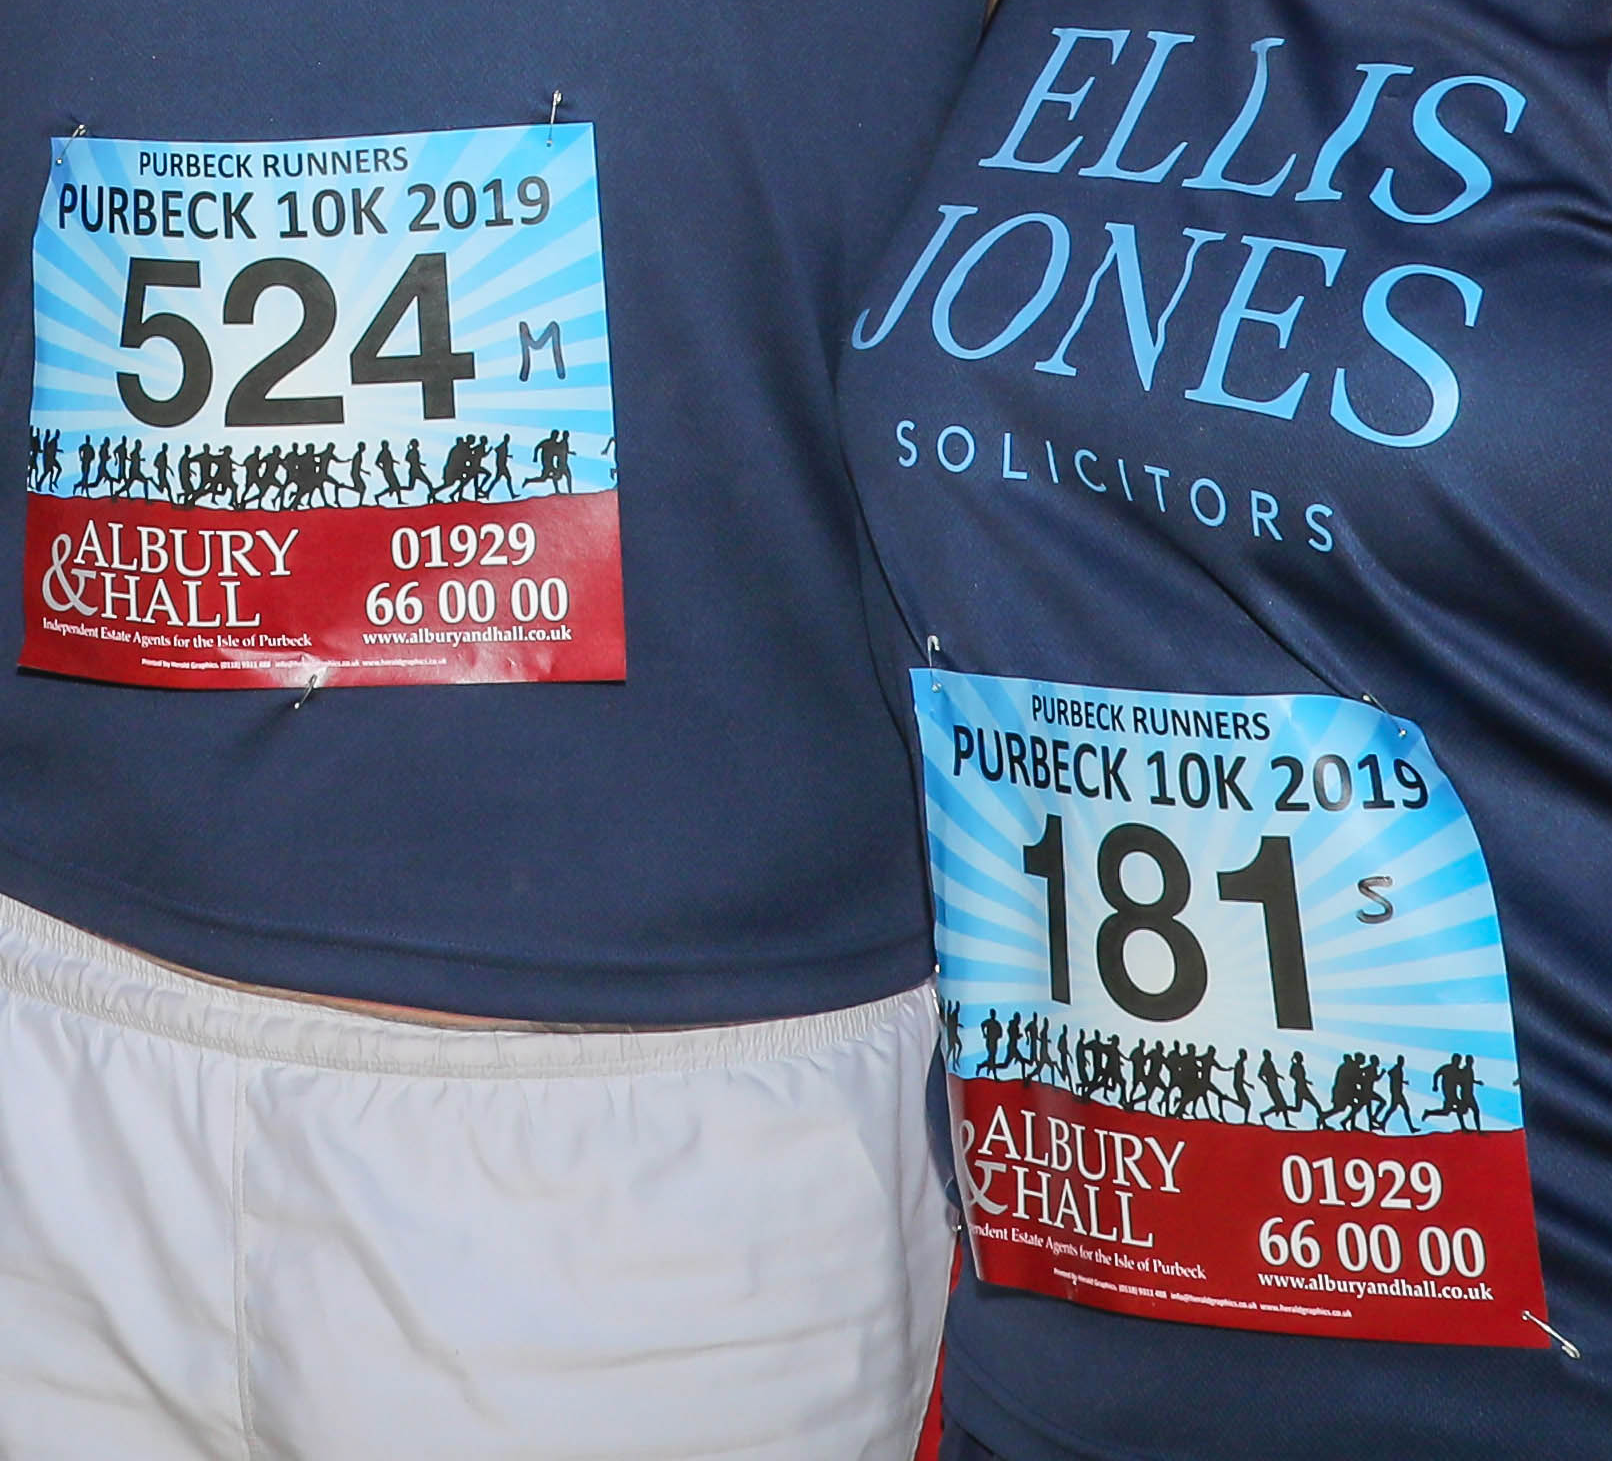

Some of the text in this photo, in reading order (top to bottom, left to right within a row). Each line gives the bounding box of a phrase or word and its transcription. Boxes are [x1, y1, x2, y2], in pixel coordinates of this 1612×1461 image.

[978, 26, 1527, 225] ELLIS
[139, 146, 408, 179] PURBECK RUNNERS
[58, 175, 550, 239] PURBECK 10K 2019
[116, 253, 475, 428] 524
[519, 320, 566, 381] M
[850, 204, 1484, 449] JONES
[895, 420, 1335, 553] SOLICITORS
[73, 519, 299, 577] ALBURY
[391, 522, 536, 570] 01929
[365, 577, 569, 626] 66 00 00
[43, 618, 312, 649] Independent Estate Agents for the Isle of Purbeck
[363, 625, 572, 649] www.alburyandhall.co.uk
[1032, 694, 1271, 741] PURBECK RUNNERS
[953, 725, 1429, 811] PURBECK 10K 2019
[1023, 814, 1314, 1031] 181
[977, 1105, 1185, 1193] ALBURY
[1282, 1154, 1443, 1211] 01929
[1011, 1228, 1043, 1246] Estate
[1046, 1237, 1077, 1255] Agents
[1079, 1245, 1093, 1261] for
[1095, 1249, 1111, 1265] the
[1114, 1253, 1134, 1270] Isle
[1137, 1258, 1150, 1271] of
[1153, 1260, 1206, 1279] Purbeck
[1258, 1217, 1486, 1277] 66 00 00
[1258, 1271, 1493, 1302] www.alburyandhall.co.uk
